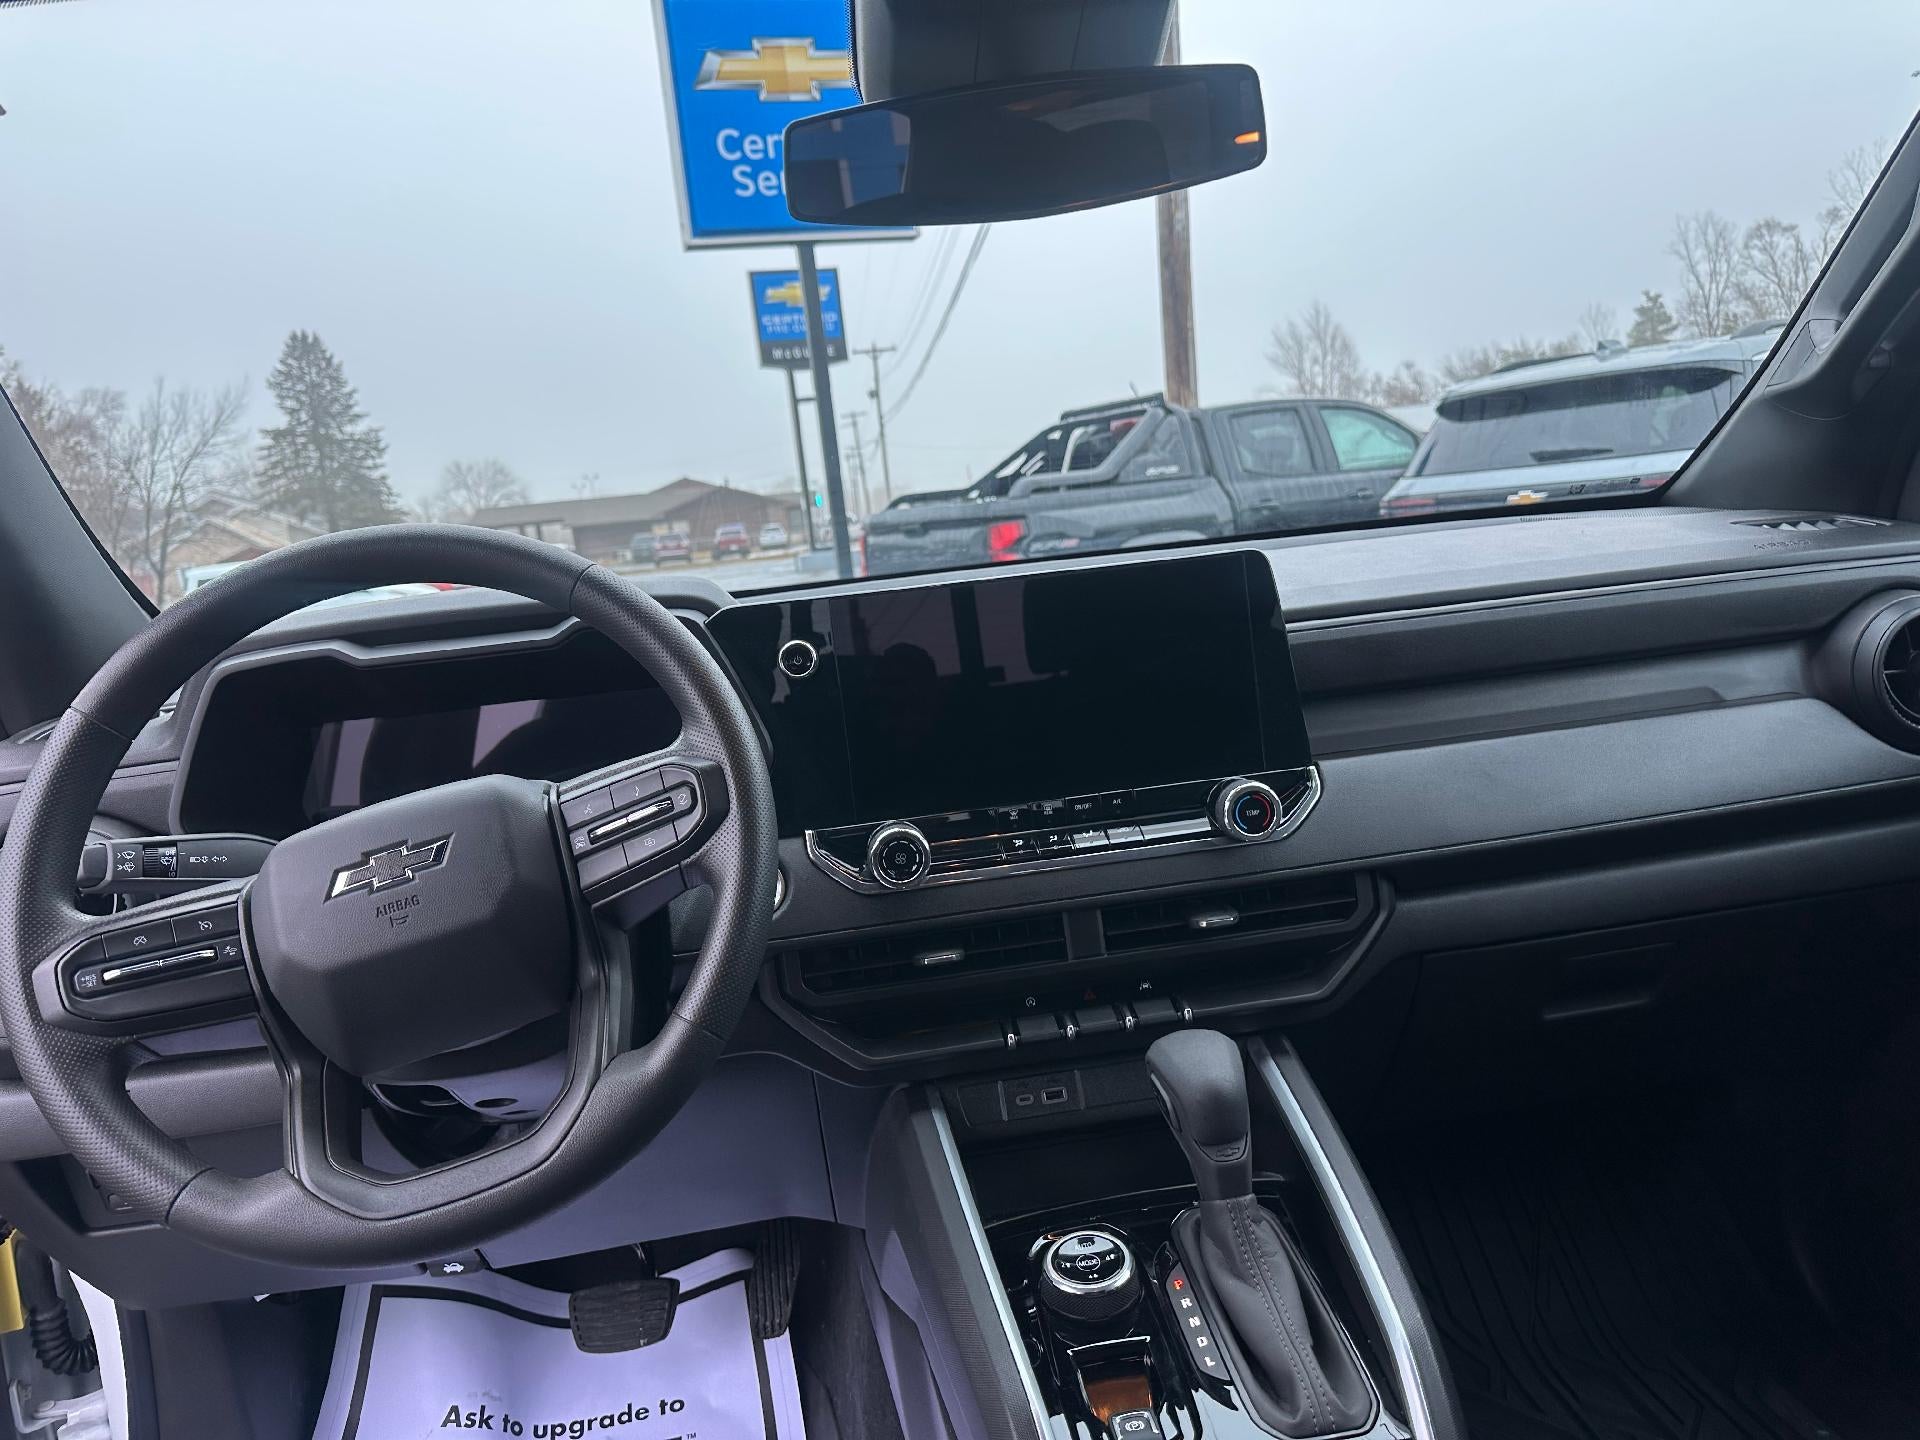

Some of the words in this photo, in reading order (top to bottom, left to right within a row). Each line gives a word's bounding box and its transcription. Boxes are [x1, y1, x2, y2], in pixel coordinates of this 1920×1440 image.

[376, 894, 420, 918] AIRBAG
[1078, 1259, 1099, 1267] MODE
[1174, 1279, 1184, 1290] P
[1180, 1297, 1193, 1309] R
[1188, 1316, 1201, 1328] N
[1196, 1336, 1208, 1348] D
[1204, 1356, 1216, 1367] L
[440, 1404, 495, 1430] Ask
[502, 1413, 524, 1437] to
[532, 1403, 650, 1440] upgrade
[659, 1399, 686, 1416] to
